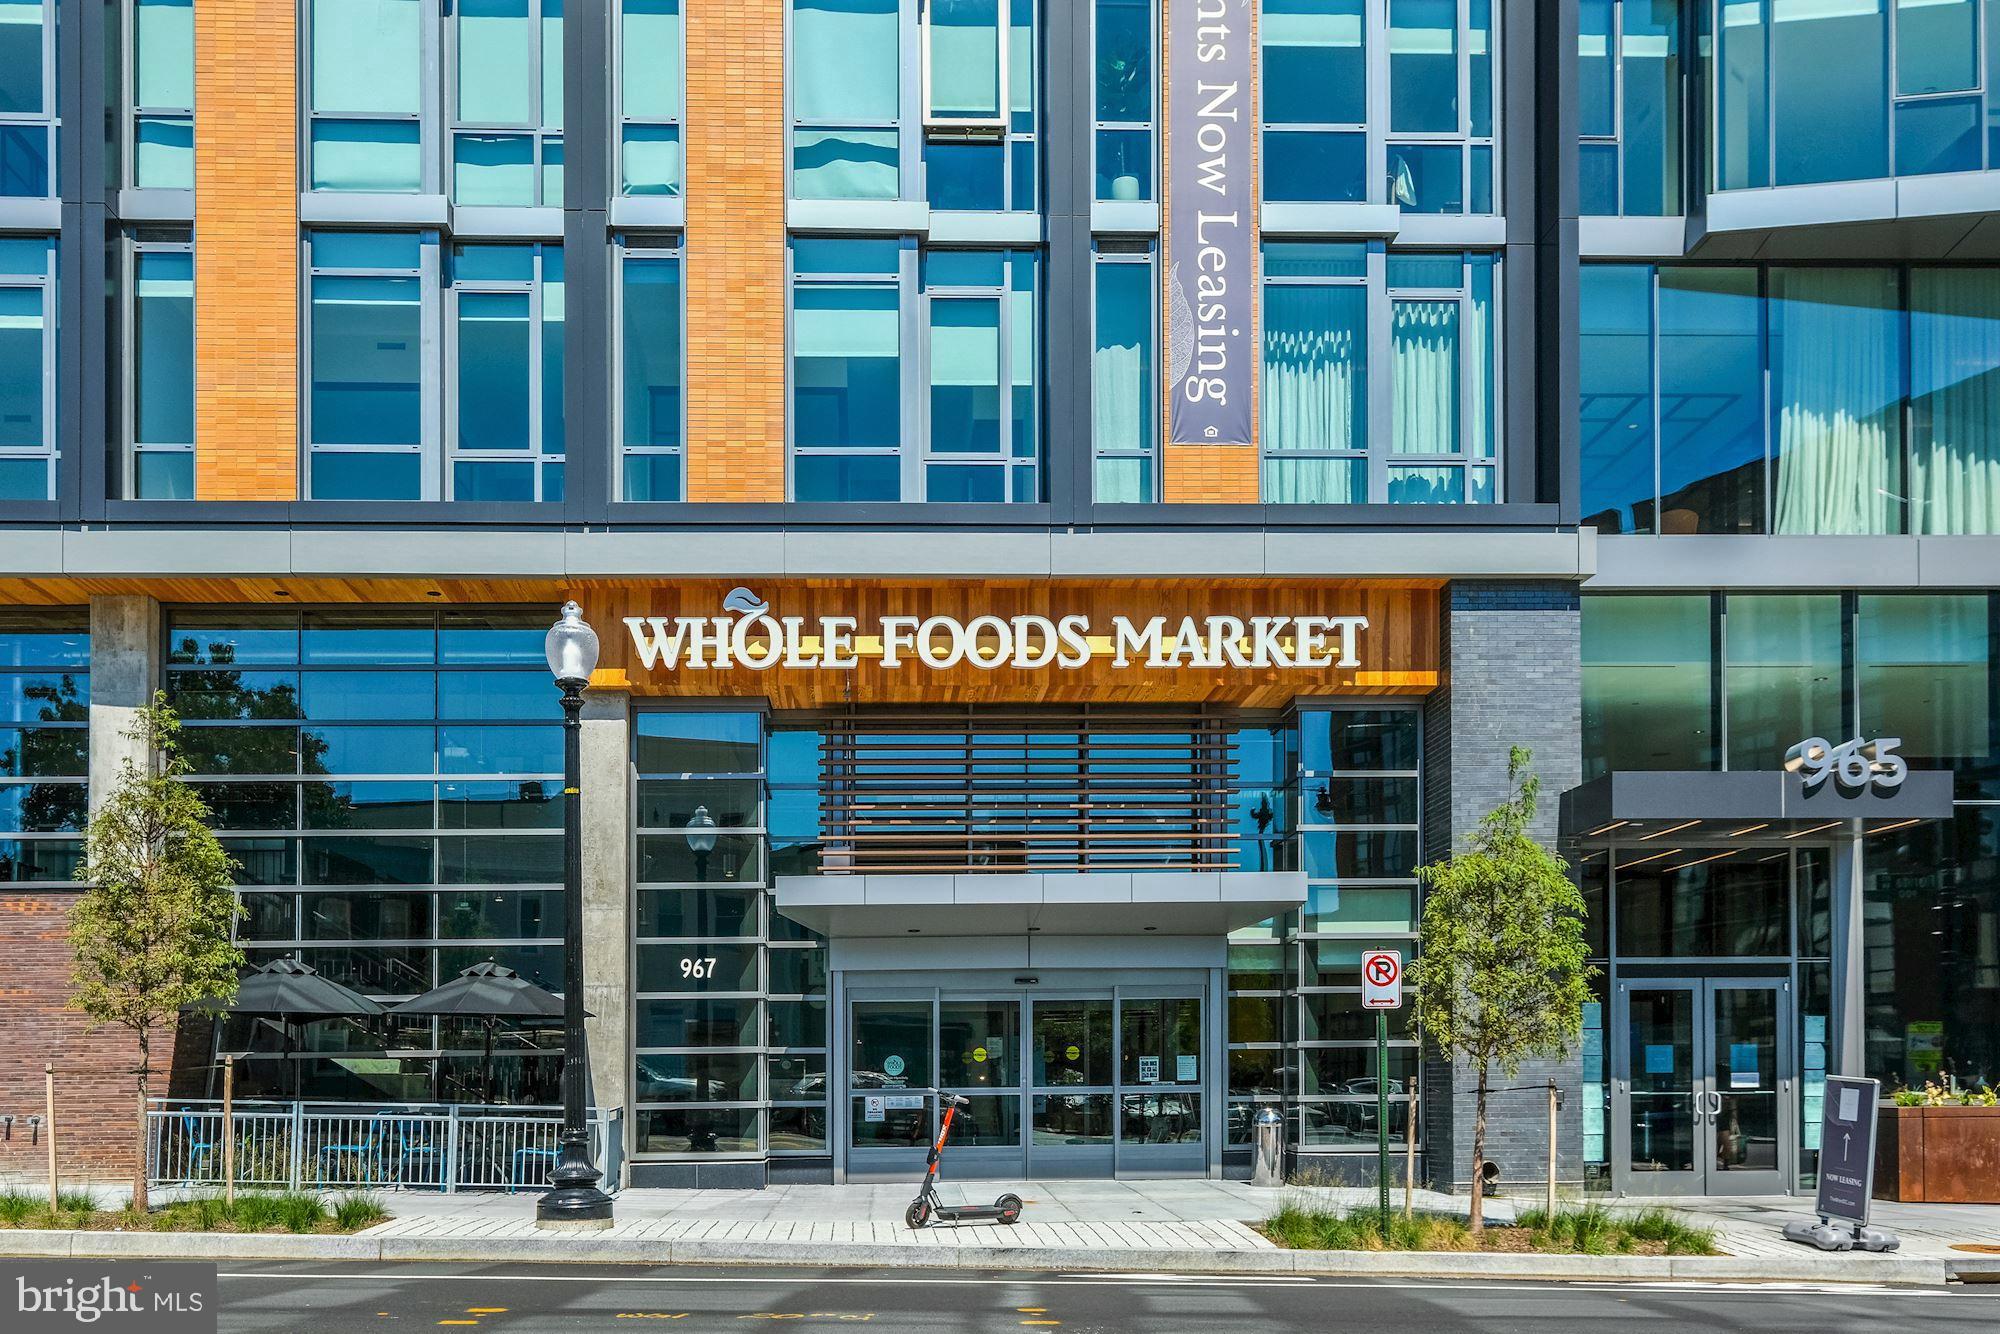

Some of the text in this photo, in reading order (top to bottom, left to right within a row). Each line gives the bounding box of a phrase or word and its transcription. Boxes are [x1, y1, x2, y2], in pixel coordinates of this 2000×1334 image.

[1197, 81, 1238, 197] Now
[1185, 211, 1240, 406] Leasing
[622, 609, 1369, 672] WHOLE FOODS MARKET
[1799, 736, 1908, 788] 965
[680, 957, 717, 979] 967
[1839, 1175, 1862, 1188] LEASING
